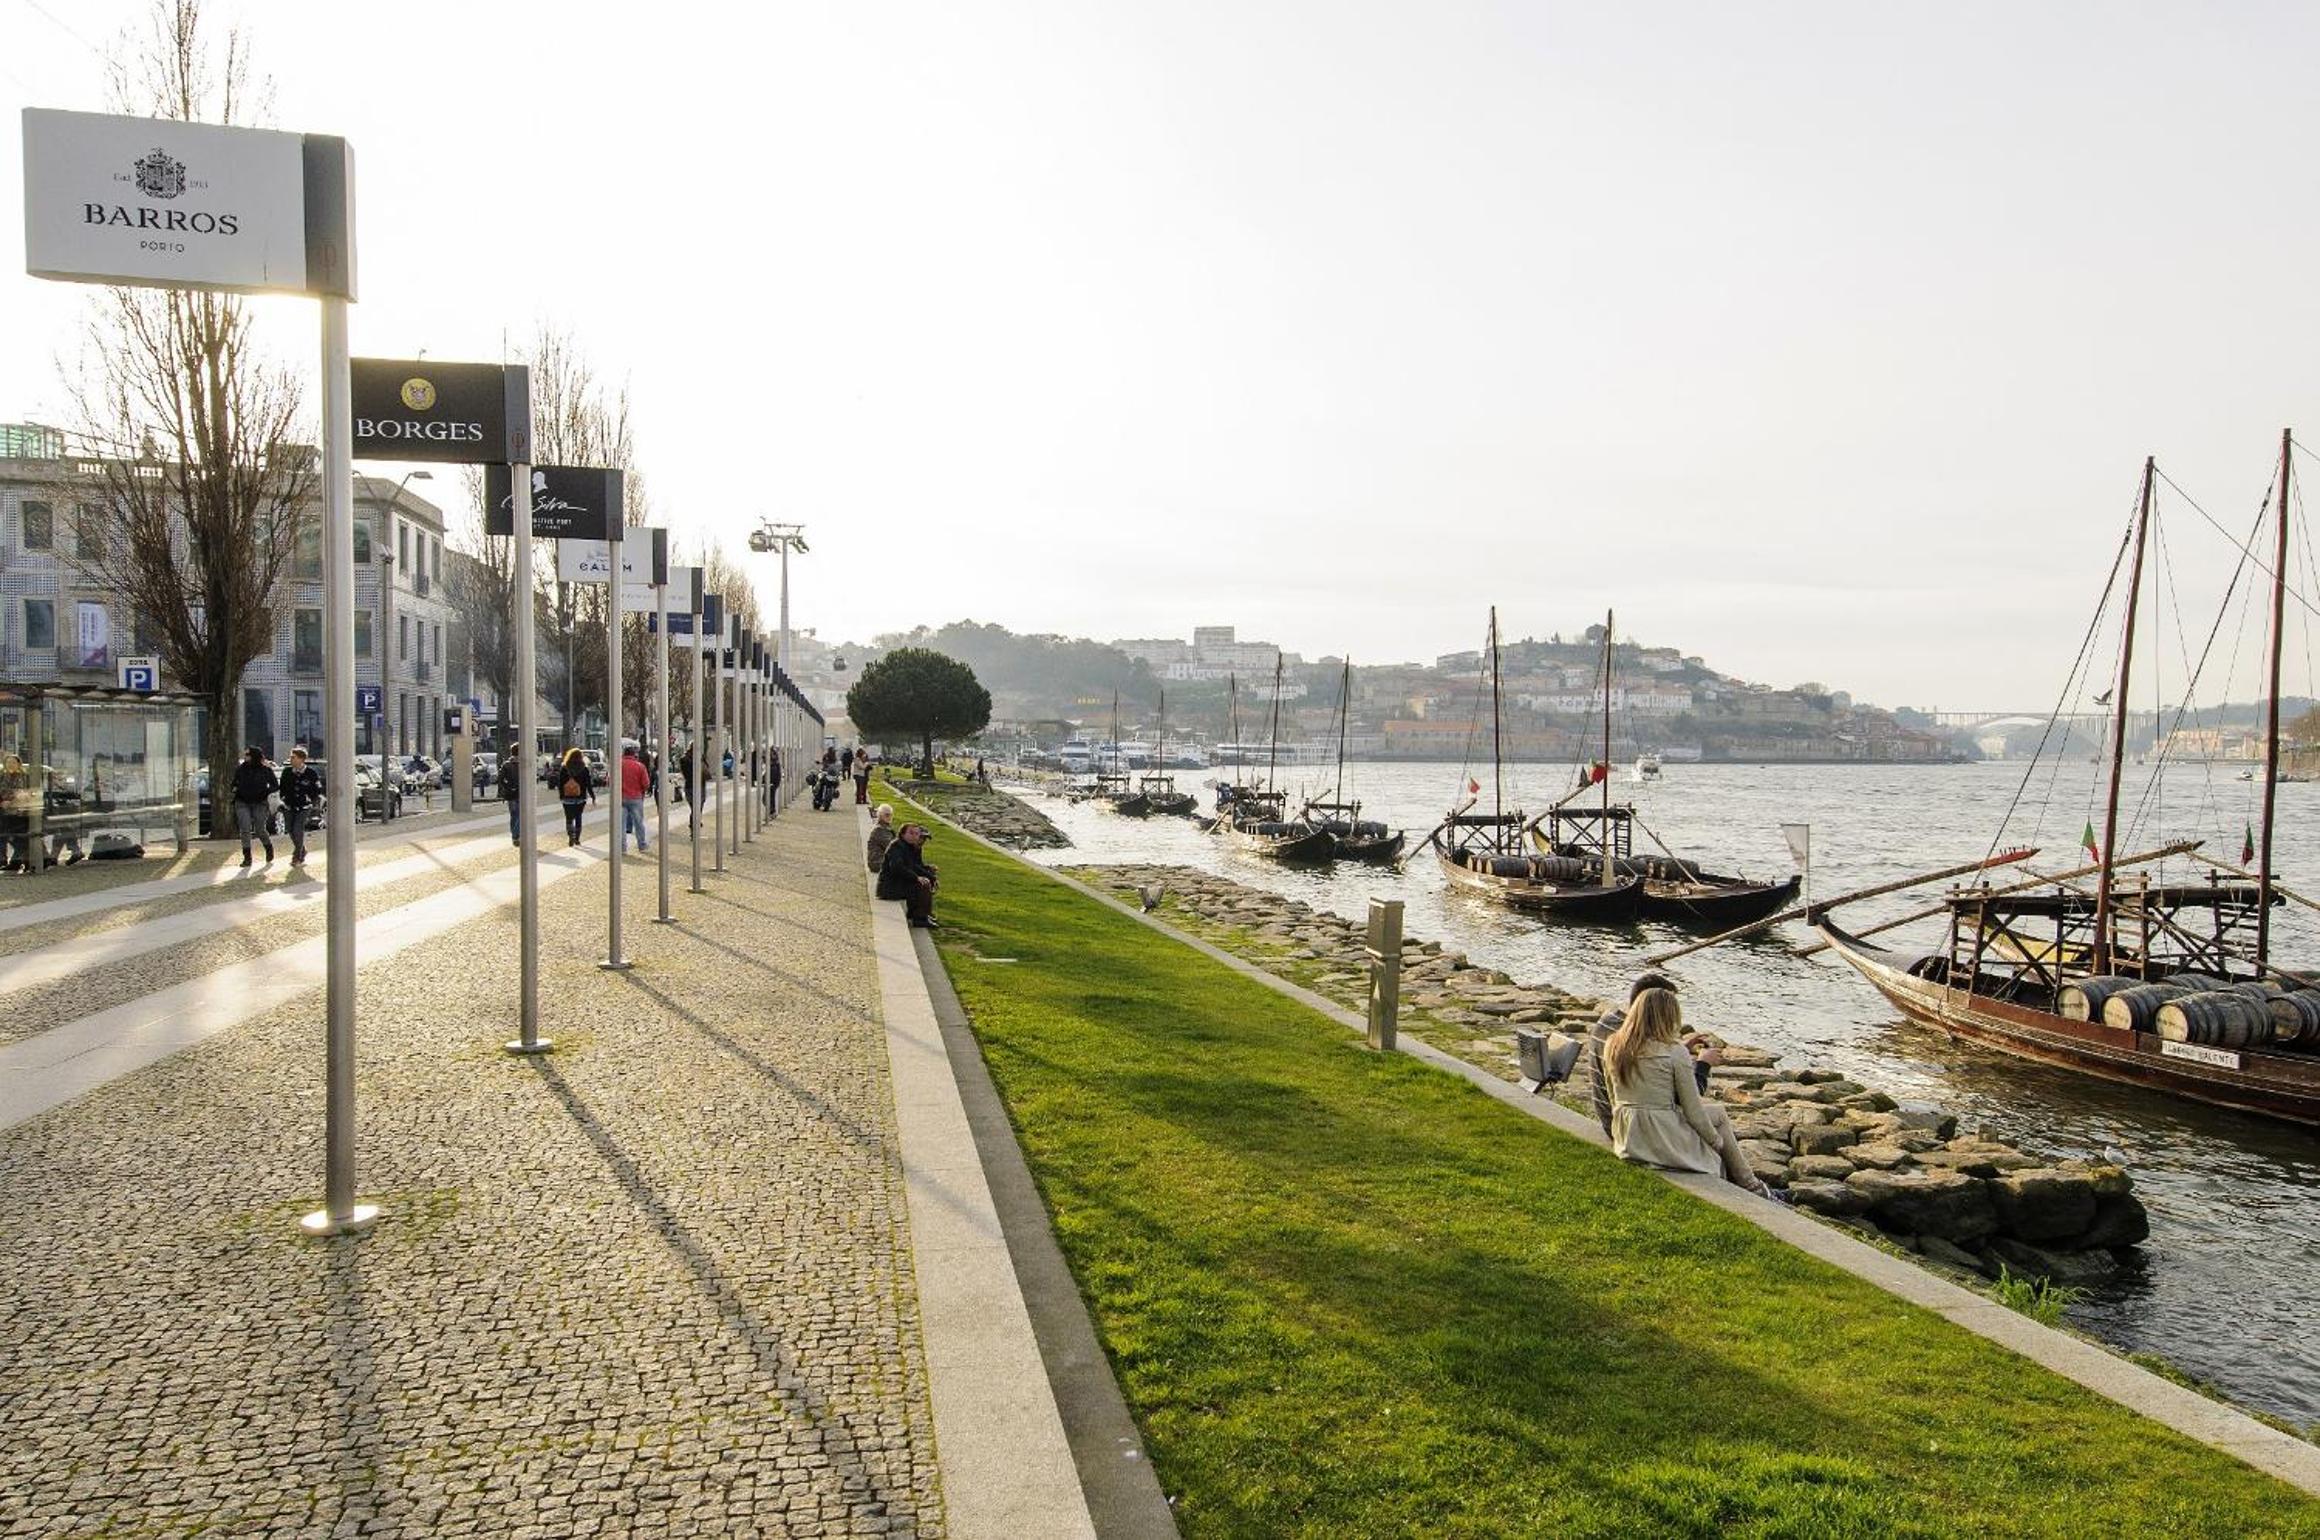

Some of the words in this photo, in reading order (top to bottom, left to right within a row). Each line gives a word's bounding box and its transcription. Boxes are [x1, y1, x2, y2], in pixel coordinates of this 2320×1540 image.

[84, 203, 238, 235] BARROS
[140, 240, 185, 253] PORTO
[356, 418, 484, 442] BORGES
[579, 562, 632, 572] CALM
[130, 671, 147, 688] P
[364, 693, 376, 706] P
